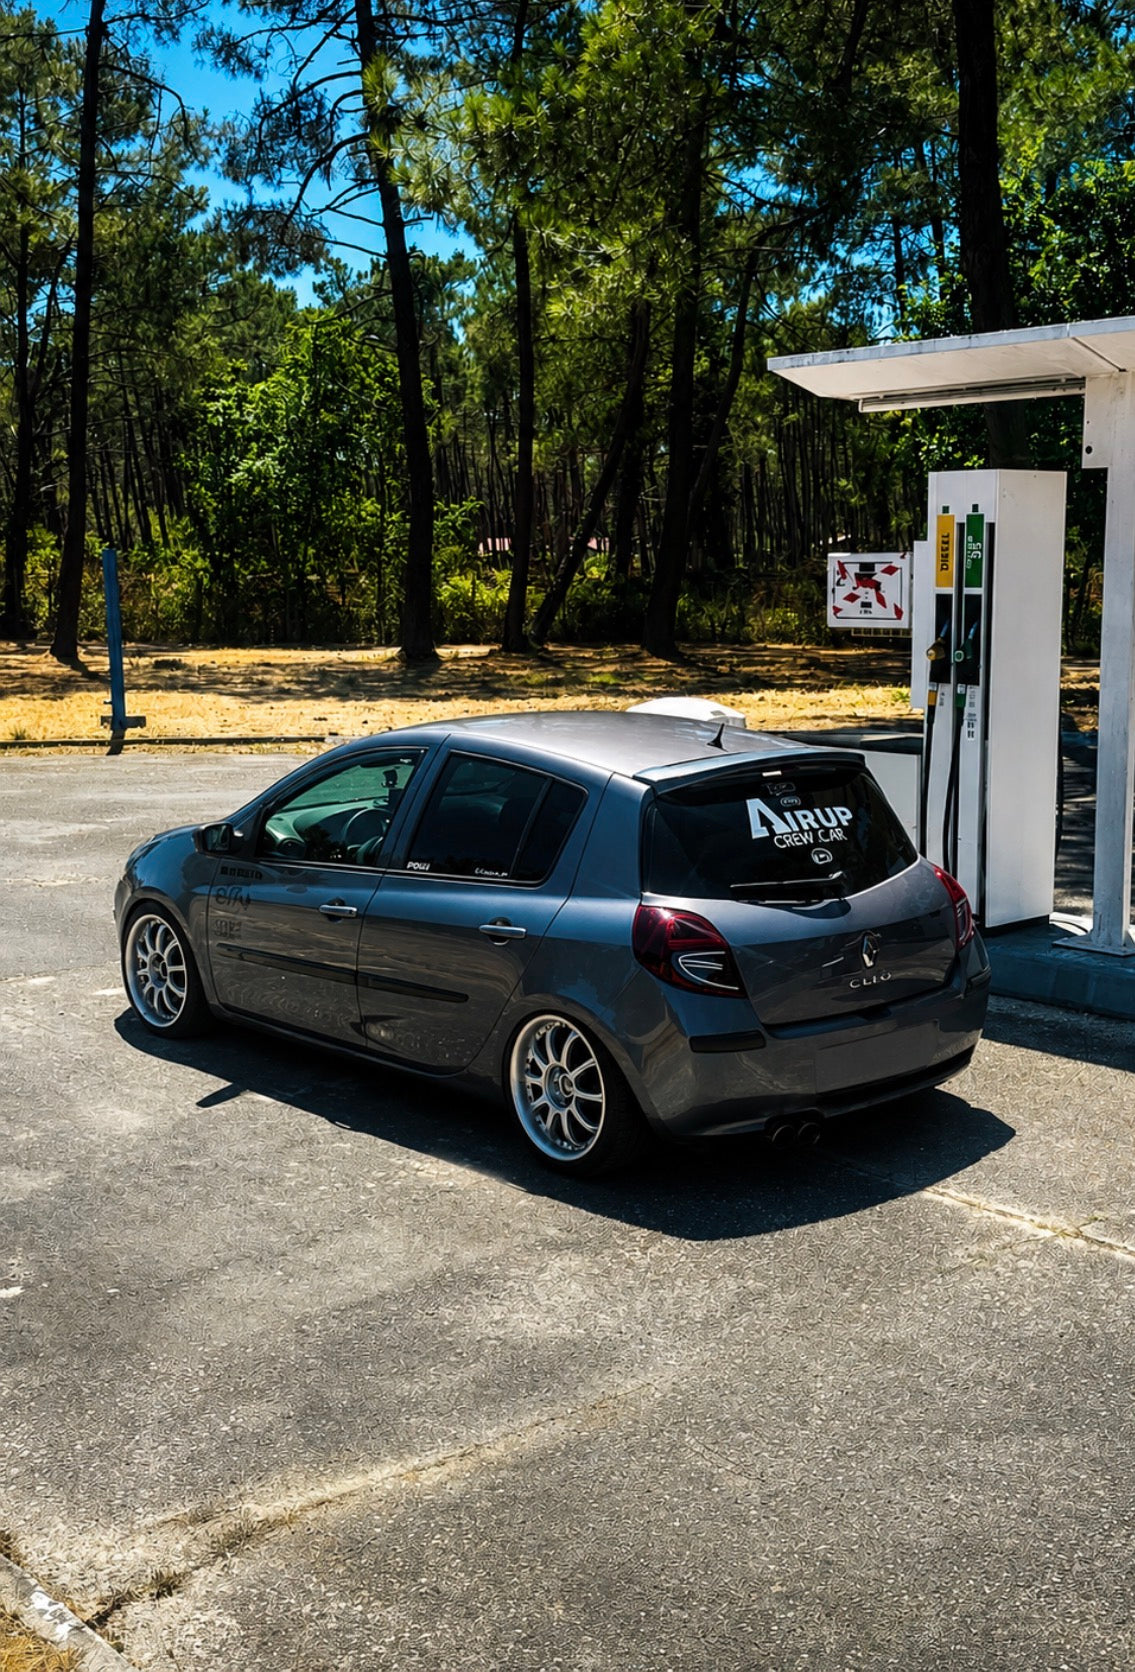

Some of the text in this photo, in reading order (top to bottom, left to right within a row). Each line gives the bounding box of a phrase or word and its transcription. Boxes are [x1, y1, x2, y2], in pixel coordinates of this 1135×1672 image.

[971, 542, 982, 559] 95
[746, 798, 853, 840] AIRUP
[773, 828, 848, 849] CREW CAR
[849, 971, 892, 989] CLIO
